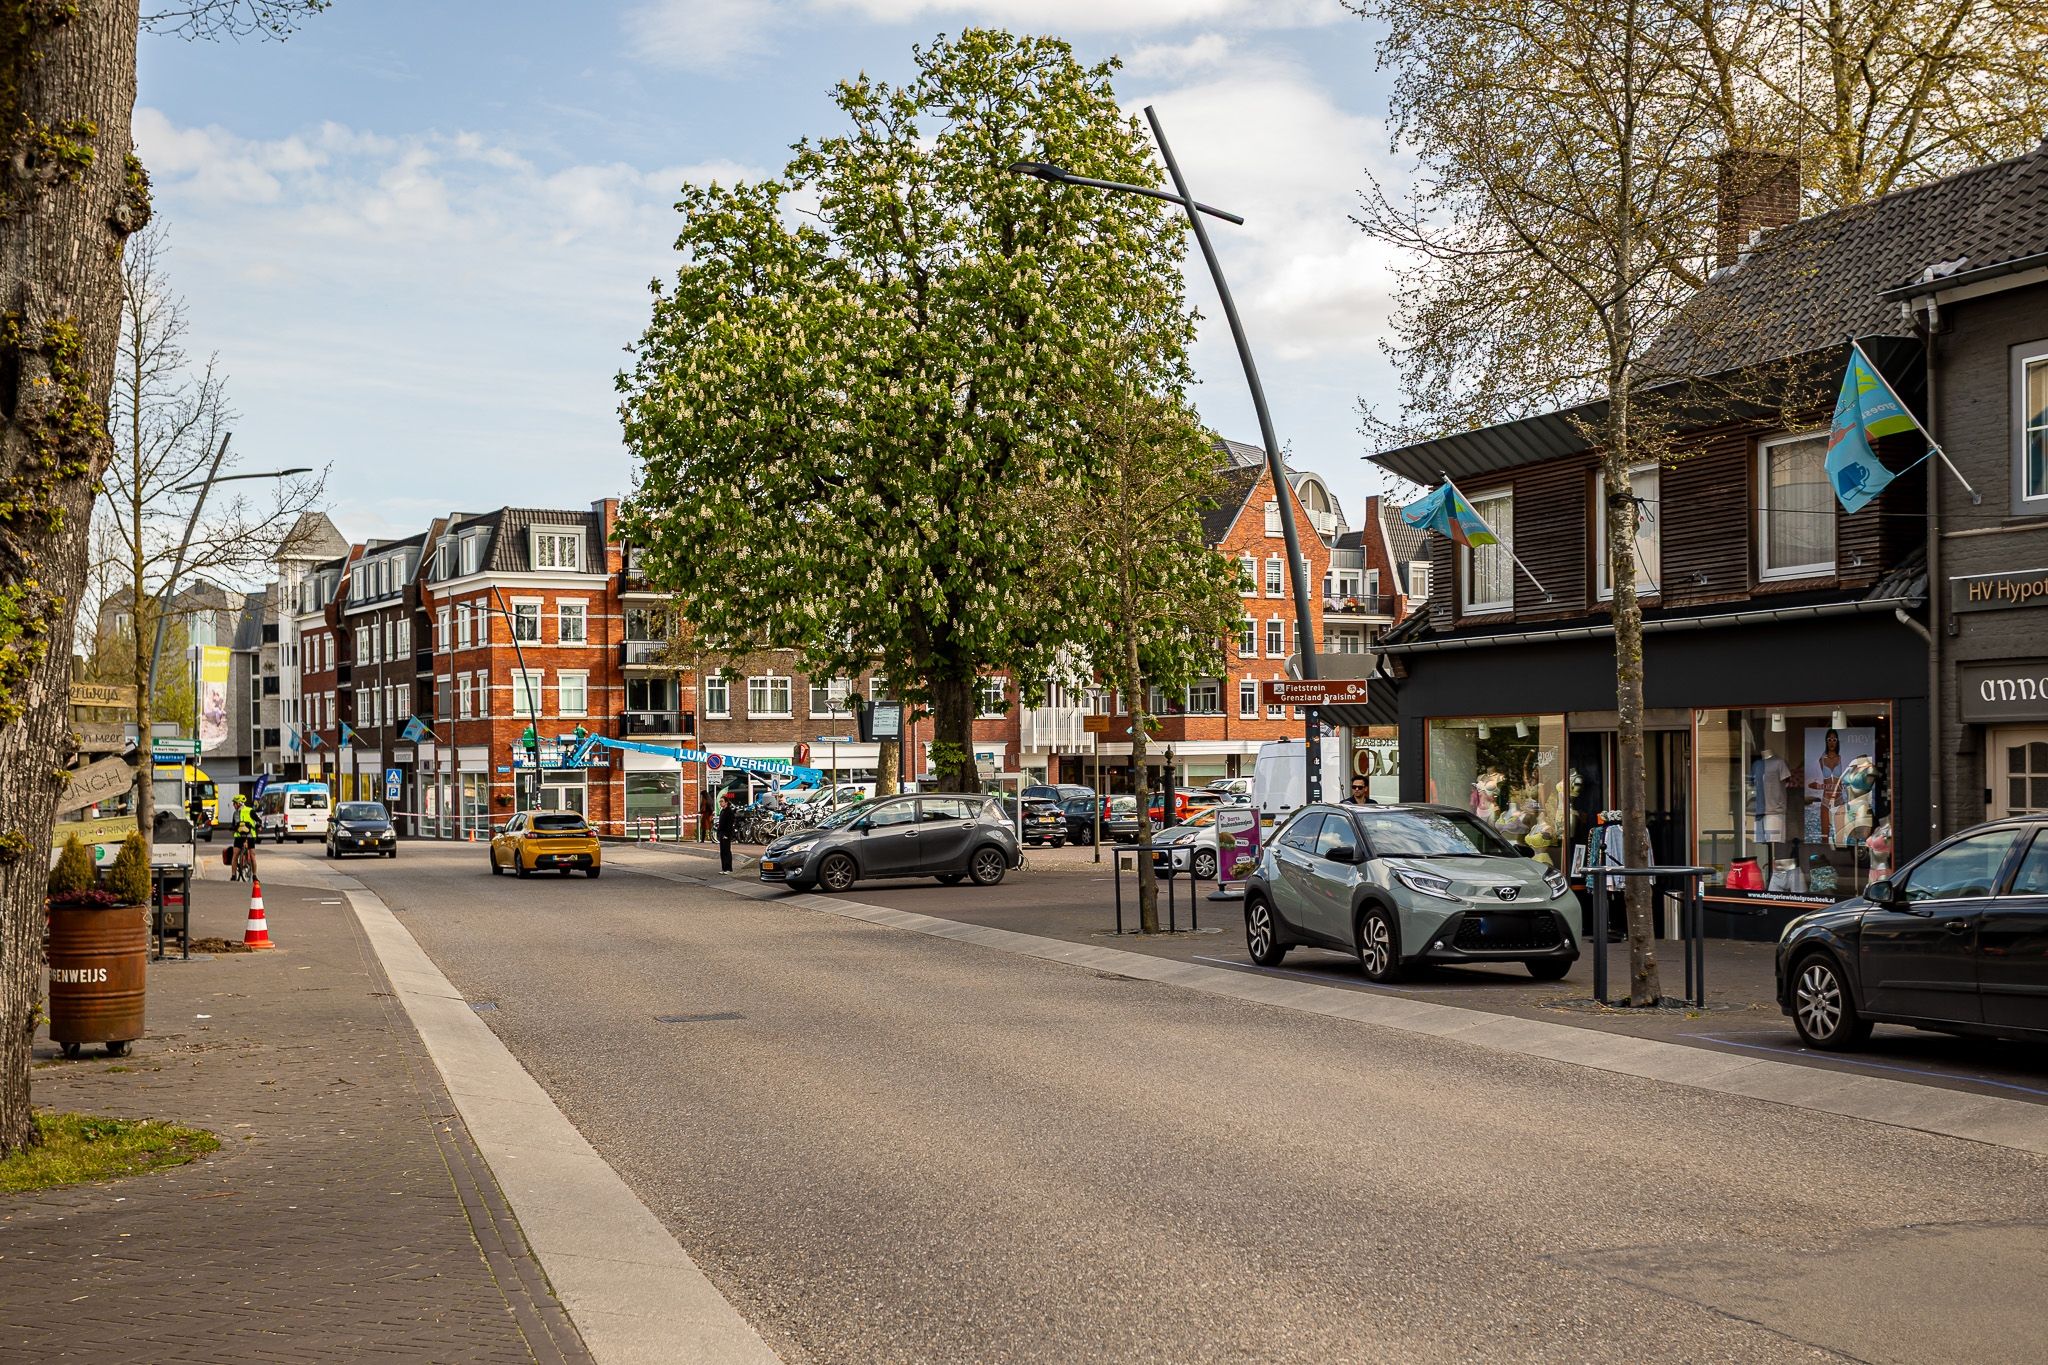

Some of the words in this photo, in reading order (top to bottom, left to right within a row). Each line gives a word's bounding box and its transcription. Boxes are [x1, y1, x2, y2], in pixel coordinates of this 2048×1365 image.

[1969, 580, 1993, 601] HV
[1285, 684, 1326, 692] Fietstrein
[731, 756, 795, 775] VERHUUR
[566, 800, 572, 808] 2
